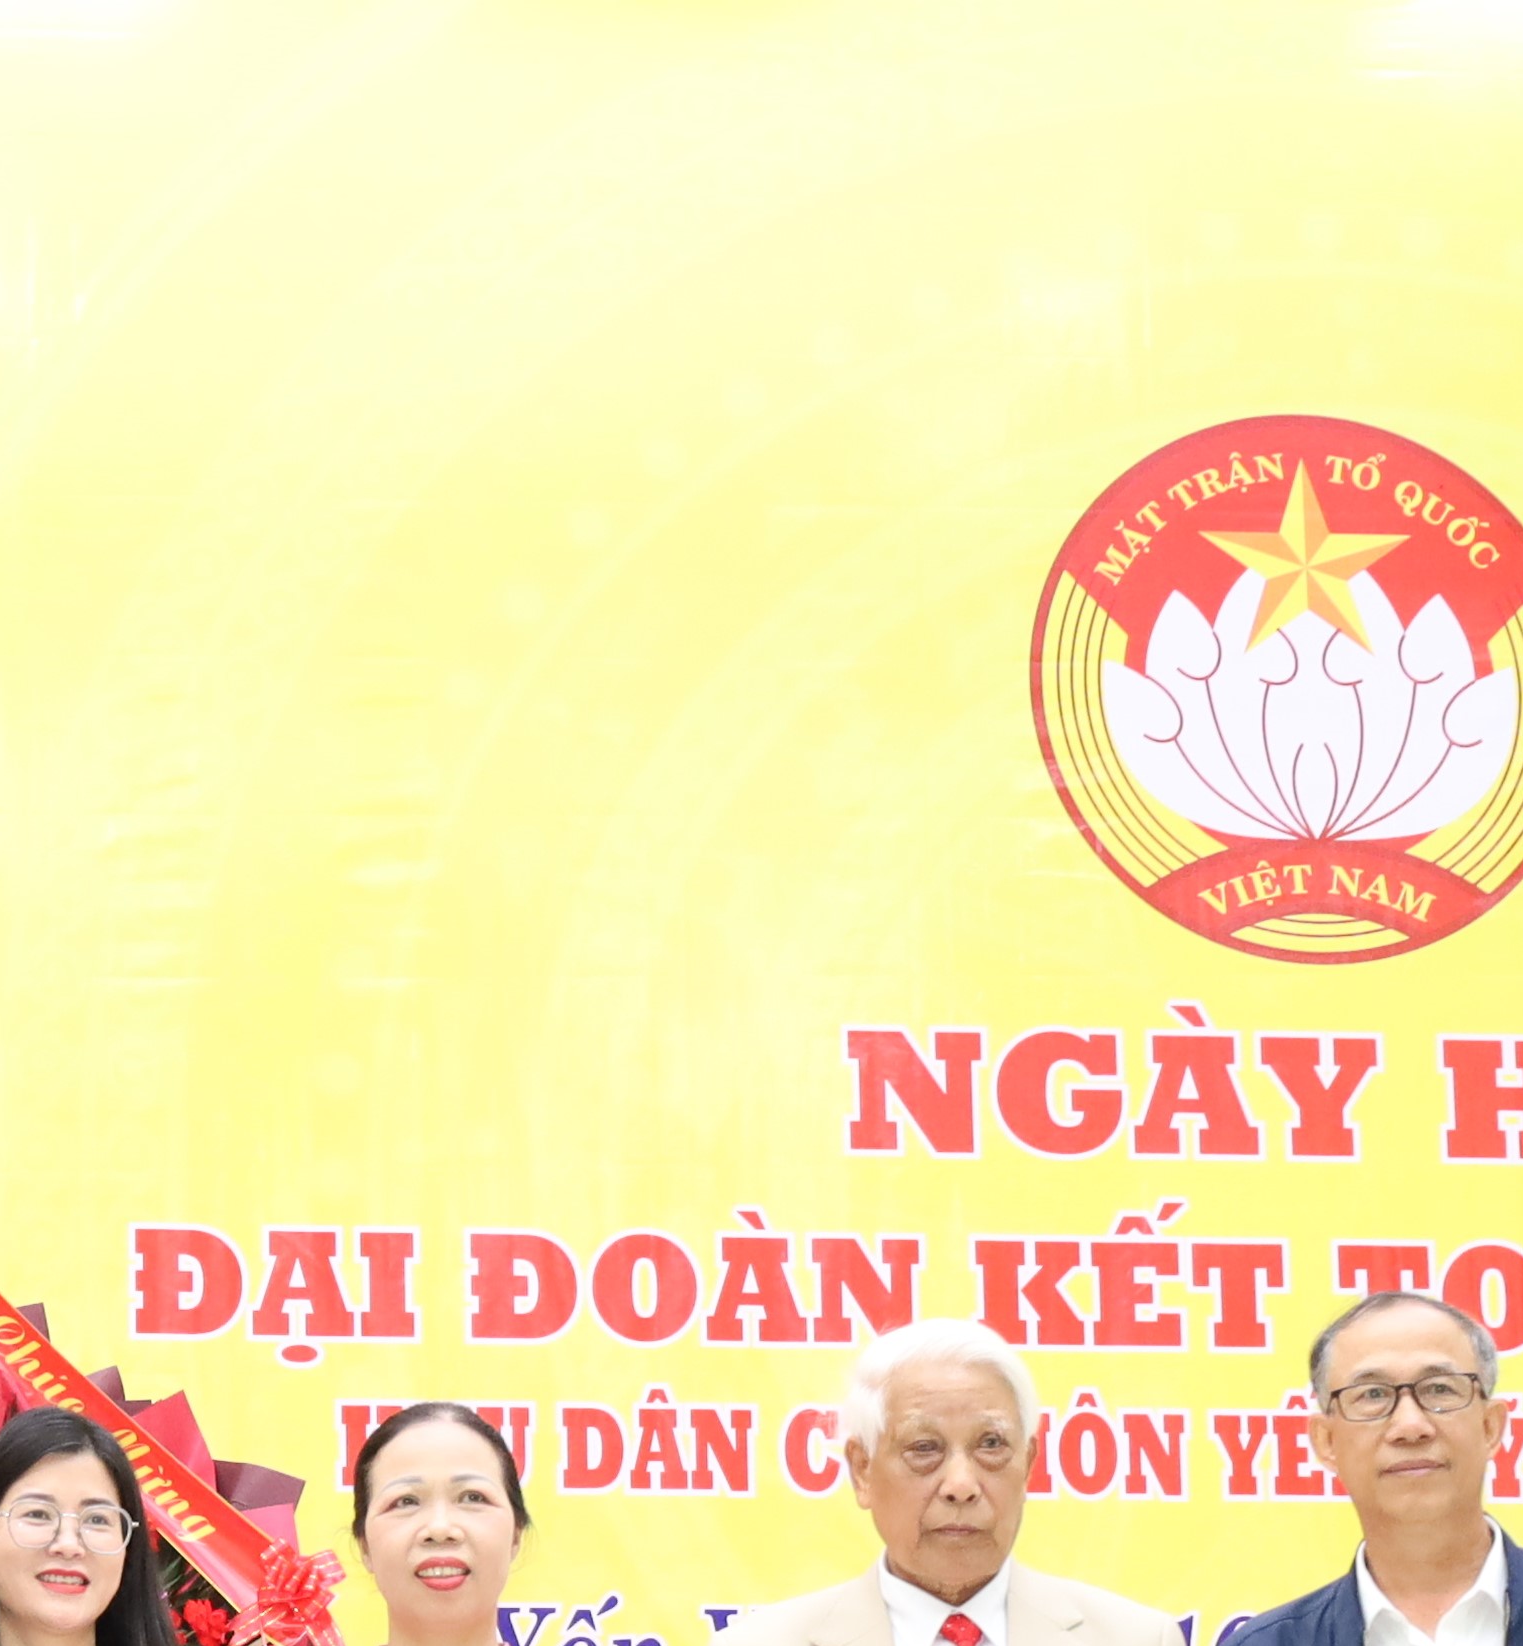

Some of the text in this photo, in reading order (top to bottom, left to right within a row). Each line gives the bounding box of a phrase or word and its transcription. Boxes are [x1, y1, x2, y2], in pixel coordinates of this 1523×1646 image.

[1094, 452, 1501, 586] MẶT TRẬN TỔ QUỐC
[1198, 861, 1437, 923] VIỆT NAM
[849, 1005, 1377, 1157] NGÀY
[134, 1228, 415, 1362] ĐẠI
[472, 1210, 917, 1343] ĐOÀN
[975, 1202, 1284, 1348] KẾT
[562, 1388, 753, 1492] DÂN
[1026, 1392, 1185, 1496] ÔN
